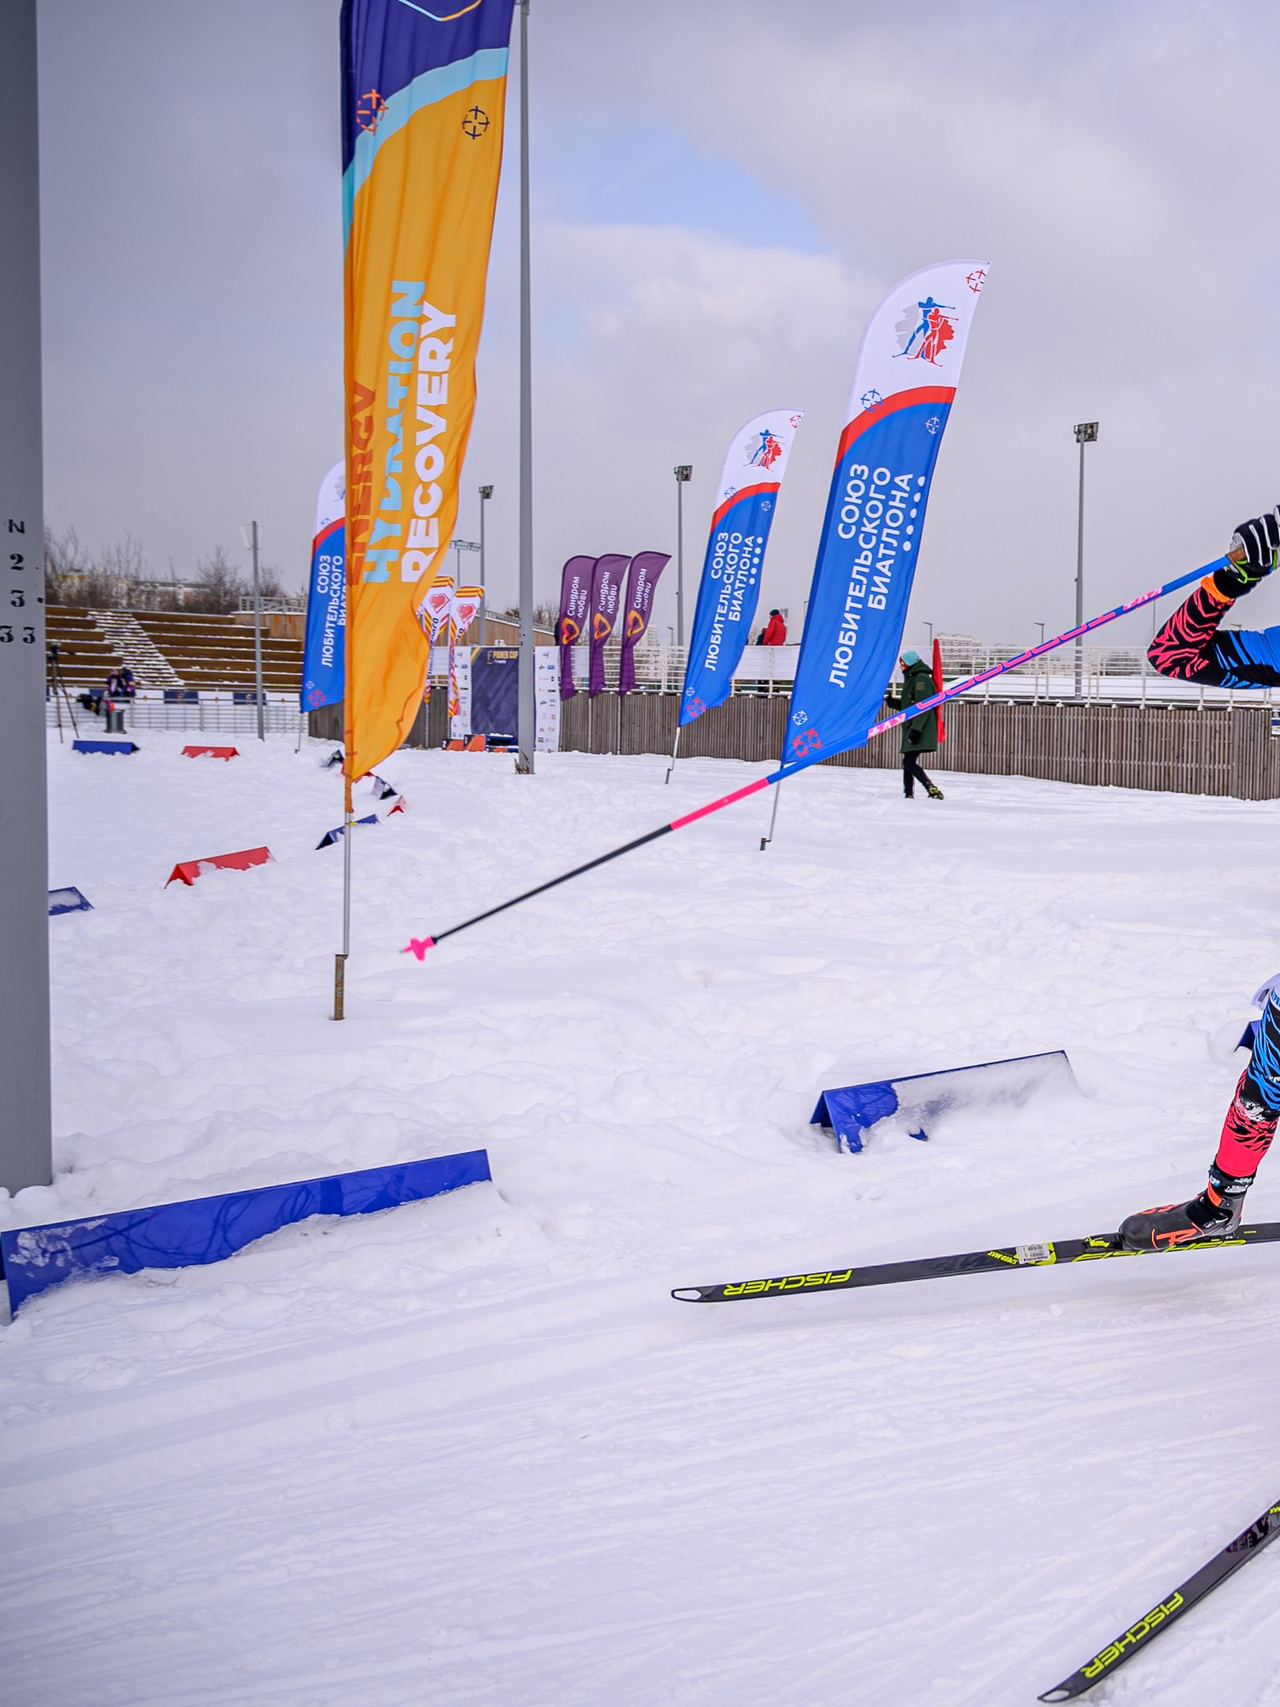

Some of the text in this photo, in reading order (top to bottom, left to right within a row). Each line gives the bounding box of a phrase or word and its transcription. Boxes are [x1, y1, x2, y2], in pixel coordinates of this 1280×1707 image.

[401, 300, 456, 583] RECOVERY
[837, 463, 869, 539] СОЮЗ
[867, 473, 914, 611] БИАТЛОНА
[317, 555, 331, 593] СОЮЗ
[710, 532, 729, 579] СОЮЗ
[728, 535, 755, 622] БИАТЛОНА
[829, 466, 891, 689] ЛЮБИТЕЛЬСКОГО
[322, 555, 343, 667] ЛЮБИТЕЛЬСКОГО
[704, 532, 742, 671] ЛЮБИТЕЛЬСКОГО
[723, 1269, 853, 1297] FISCHER
[1080, 1591, 1185, 1679] FISCHER
